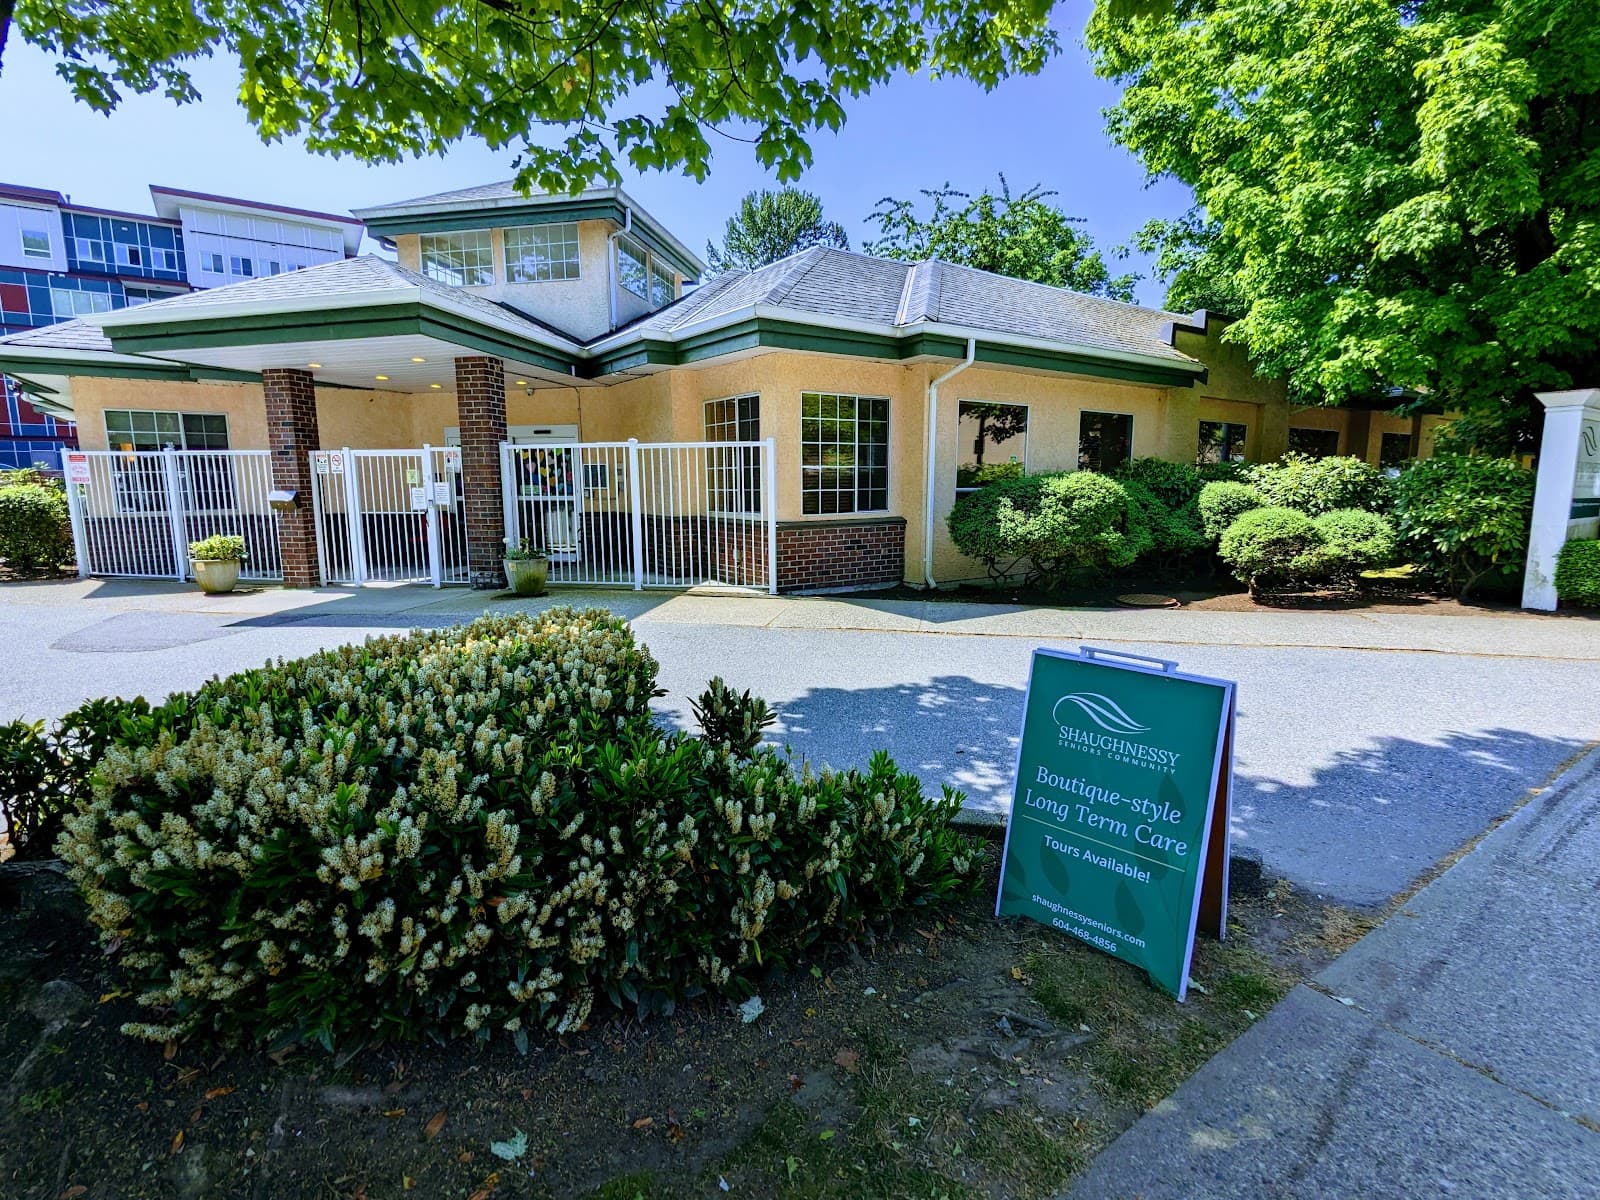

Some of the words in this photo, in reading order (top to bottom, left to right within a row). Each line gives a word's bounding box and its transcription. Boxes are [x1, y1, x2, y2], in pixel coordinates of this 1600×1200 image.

[1058, 739, 1101, 756] SENIORS
[1107, 752, 1176, 775] COMMUNITY
[1059, 725, 1180, 766] SHAUGHNESSY
[1036, 765, 1181, 823] Boutique-style
[1025, 789, 1069, 822] Long
[1075, 804, 1128, 836] Term
[1135, 824, 1188, 856] Care
[1044, 835, 1080, 858] Tours
[1082, 850, 1151, 883] Available!
[1031, 894, 1146, 948] shaughnessyseniors.com
[1052, 917, 1117, 952] 604-468-4856
